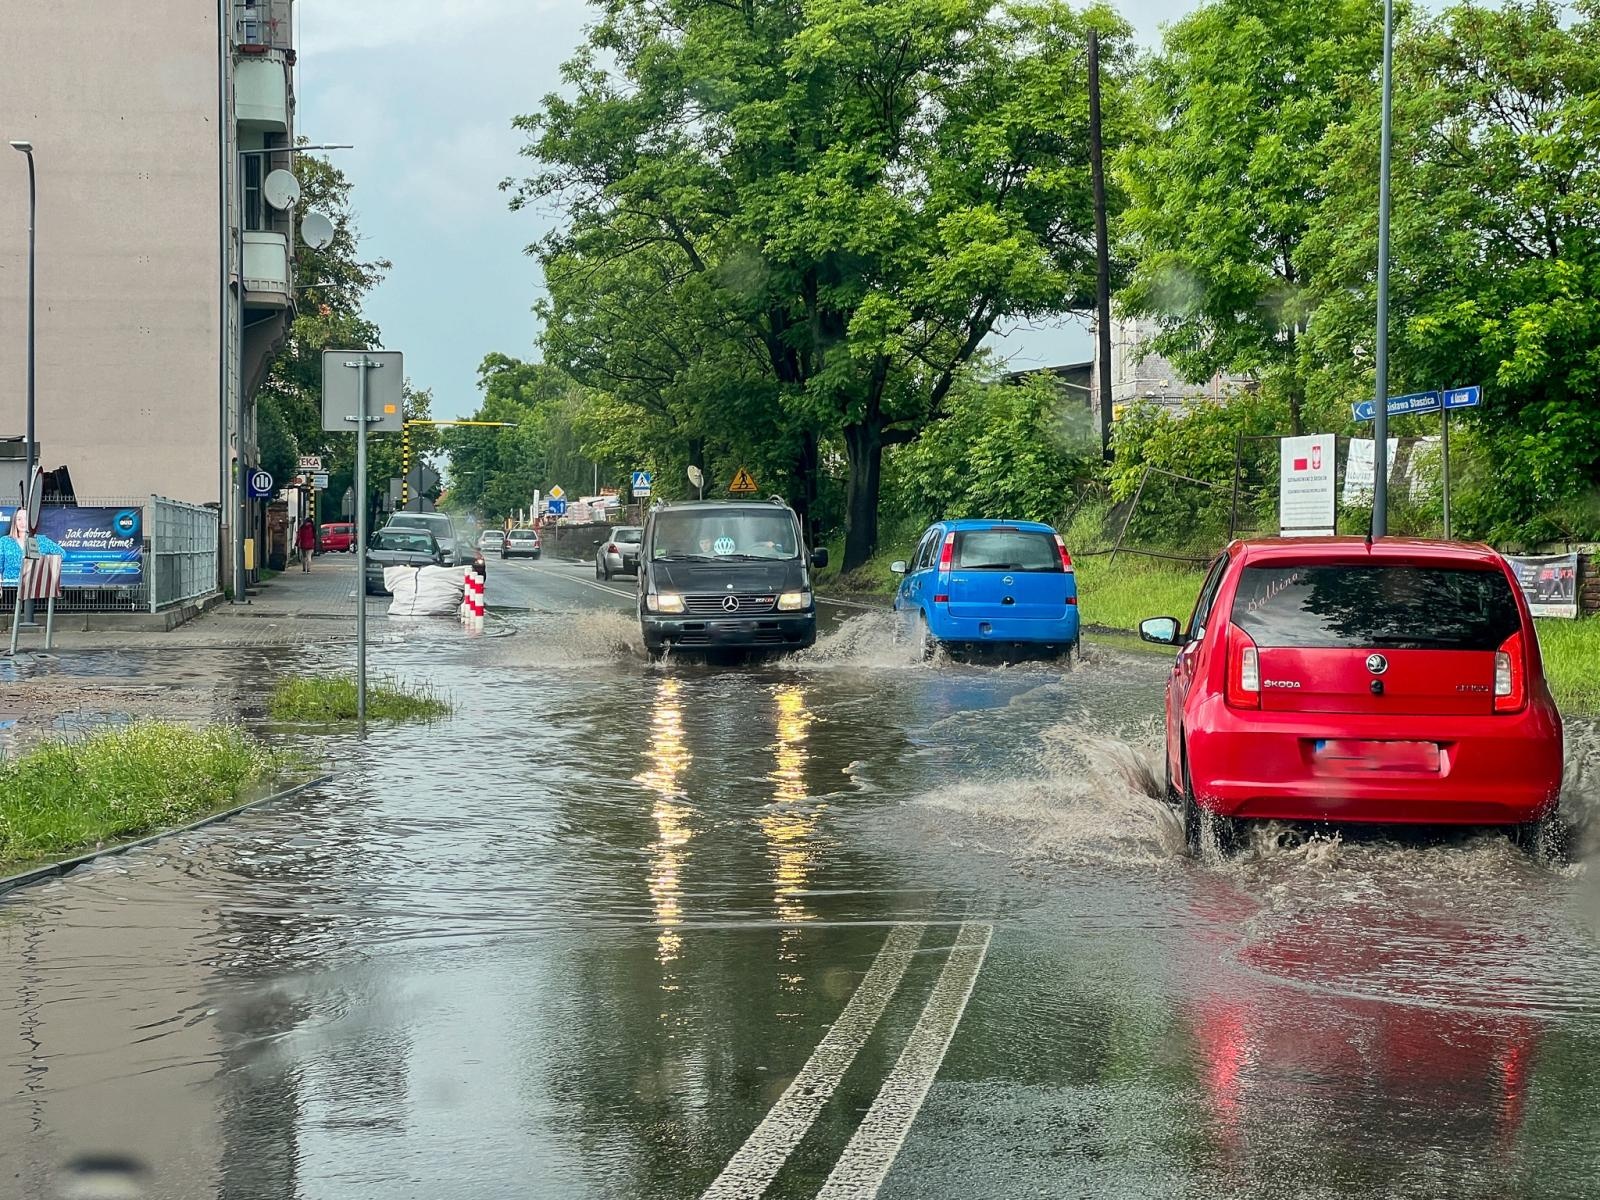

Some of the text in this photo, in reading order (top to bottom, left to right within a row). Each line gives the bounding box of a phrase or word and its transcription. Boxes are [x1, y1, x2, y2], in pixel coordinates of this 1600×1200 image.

[1410, 396, 1435, 408] Staszica
[301, 457, 320, 467] EKA
[65, 528, 112, 539] Jak dobrze
[82, 540, 107, 549] naszą
[108, 537, 134, 549] firmę?
